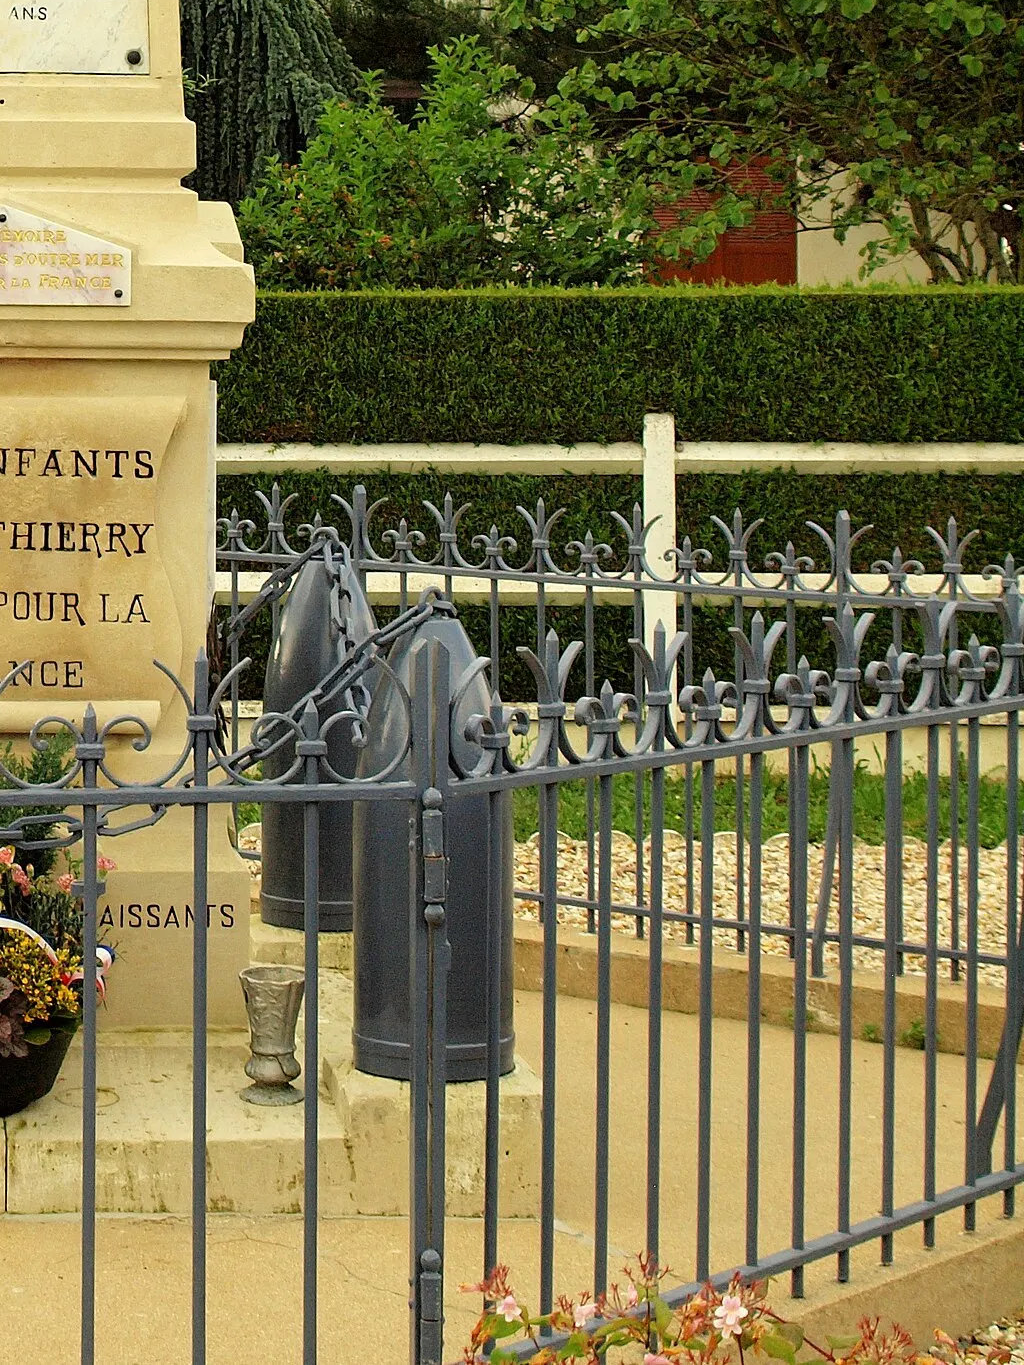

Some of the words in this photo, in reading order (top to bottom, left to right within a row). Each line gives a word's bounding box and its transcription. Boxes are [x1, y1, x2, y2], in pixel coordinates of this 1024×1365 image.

[10, 7, 47, 20] ANS
[85, 253, 124, 266] MER
[12, 278, 30, 289] LA
[40, 274, 111, 290] FRANCE
[99, 594, 150, 623] LA
[81, 904, 234, 928] AISSANTS
